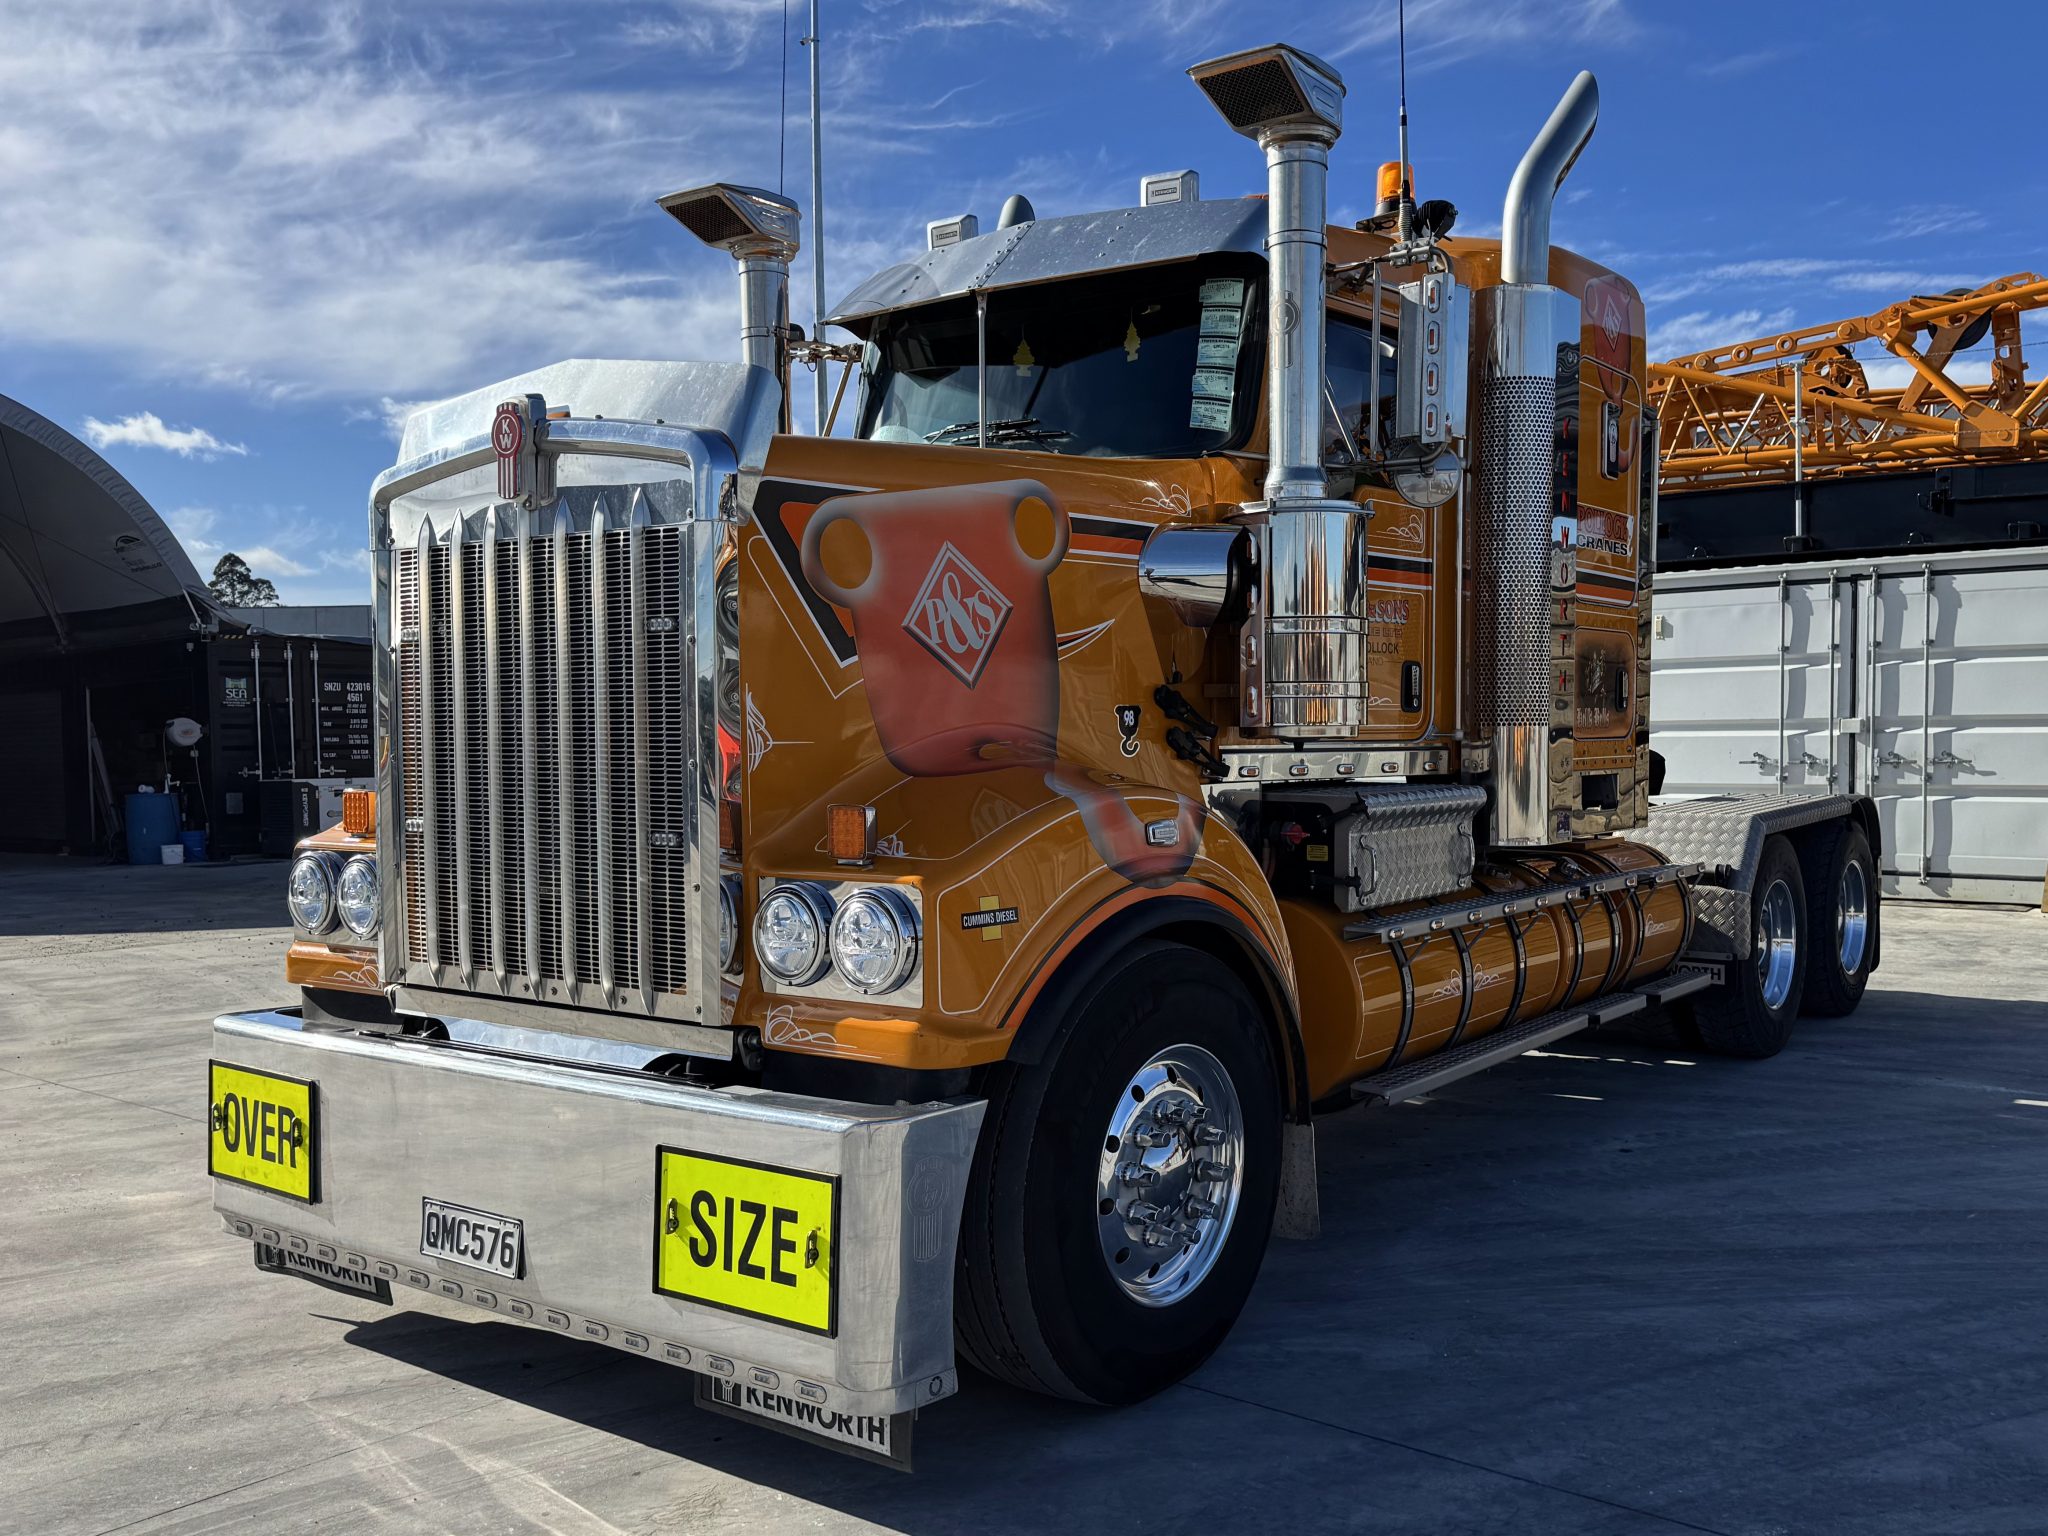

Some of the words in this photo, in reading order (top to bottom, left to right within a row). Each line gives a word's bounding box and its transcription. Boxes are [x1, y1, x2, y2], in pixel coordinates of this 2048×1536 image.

[1576, 534, 1628, 556] CRANES
[925, 572, 996, 653] P&S
[1376, 599, 1409, 624] SONS
[225, 688, 247, 699] SEA
[324, 682, 341, 692] SNZU
[1123, 710, 1135, 726] 98
[963, 912, 995, 927] CUMMINS
[995, 910, 1018, 923] DIESEL
[222, 1093, 297, 1169] OVER
[426, 1211, 515, 1269] QMC576
[689, 1189, 799, 1288] SIZE
